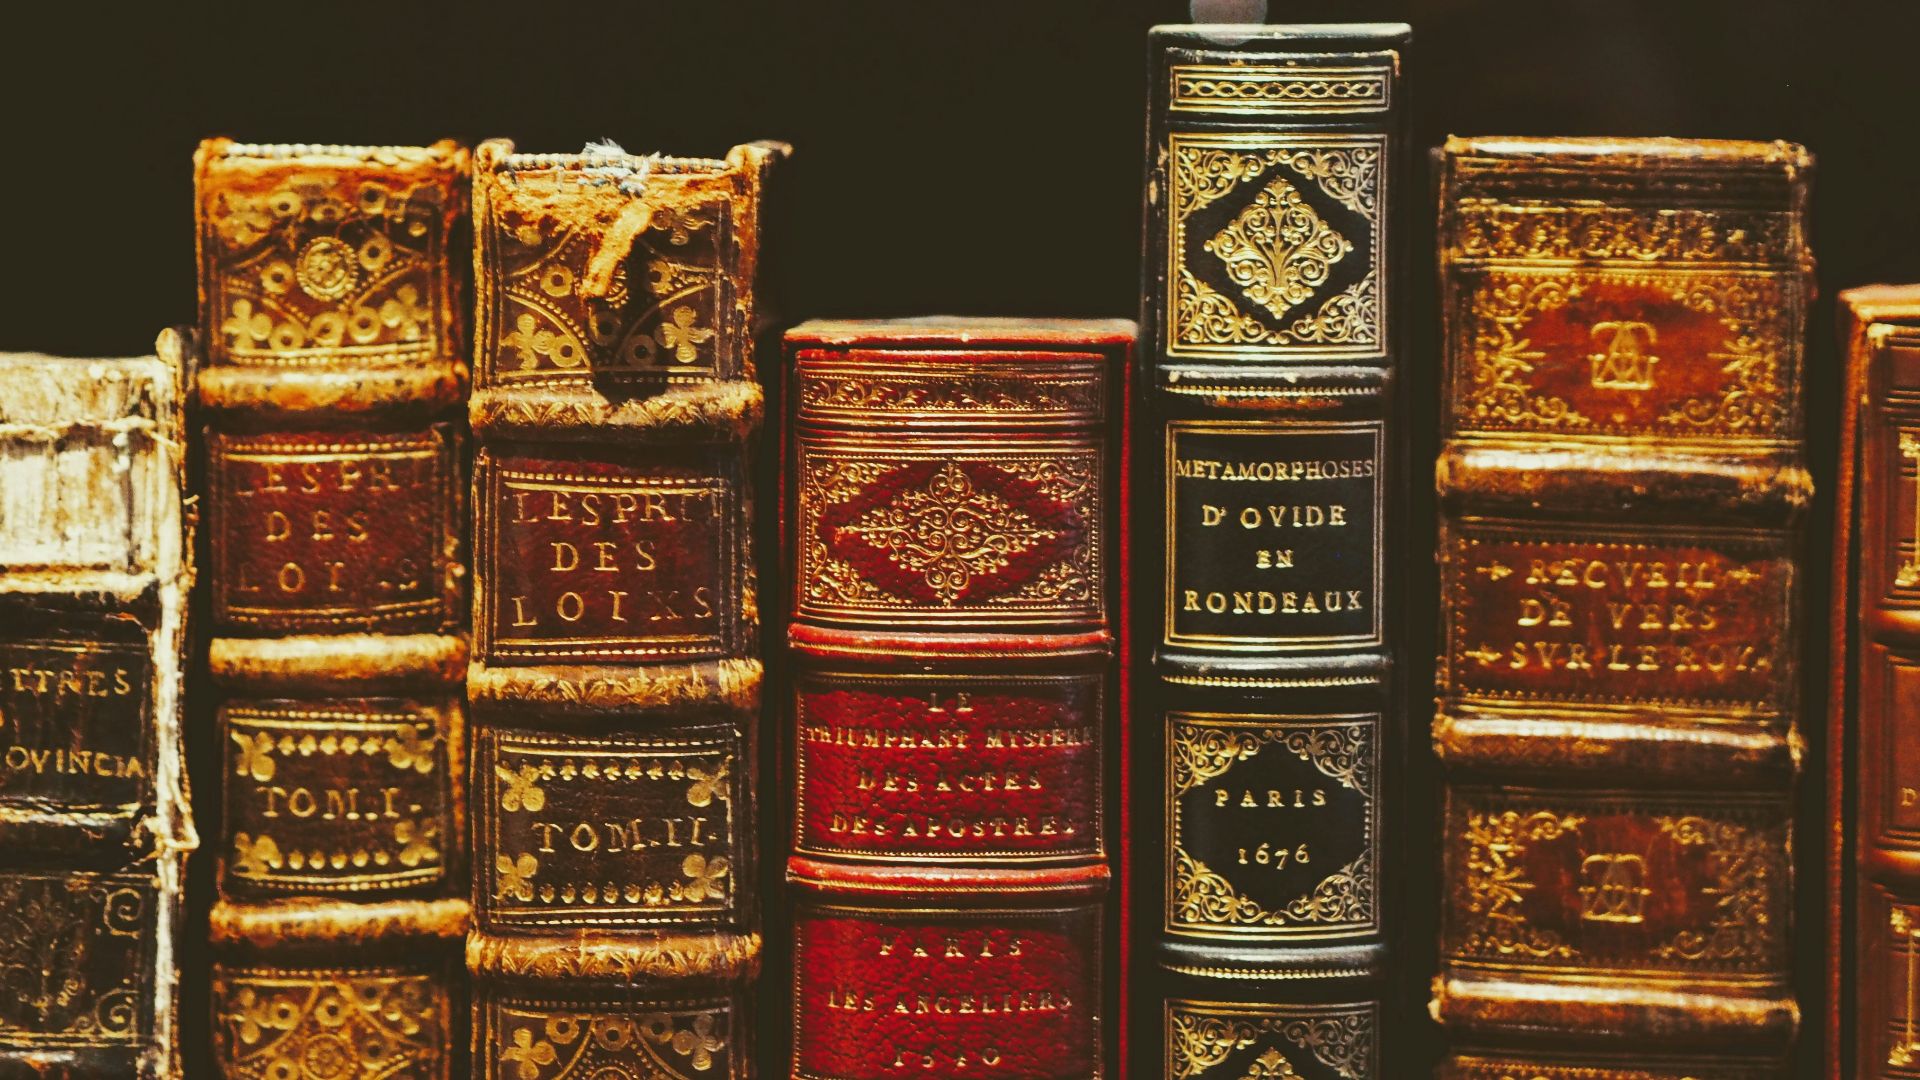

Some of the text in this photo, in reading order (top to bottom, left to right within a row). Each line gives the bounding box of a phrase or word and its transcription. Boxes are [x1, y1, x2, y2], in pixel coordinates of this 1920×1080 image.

[1176, 459, 1374, 481] METAMORPHOSES
[266, 510, 369, 543] DES
[1240, 505, 1347, 529] OVIDE
[551, 540, 657, 572] DES
[1256, 549, 1294, 569] EN
[240, 562, 418, 593] LOIS
[511, 586, 713, 626] LOIXS
[1184, 590, 1363, 614] RONDEAUX
[1518, 598, 1718, 631] DE VERS
[0, 668, 130, 697] TTRES
[1214, 789, 1327, 808] PARIS
[1238, 842, 1310, 870] 1676
